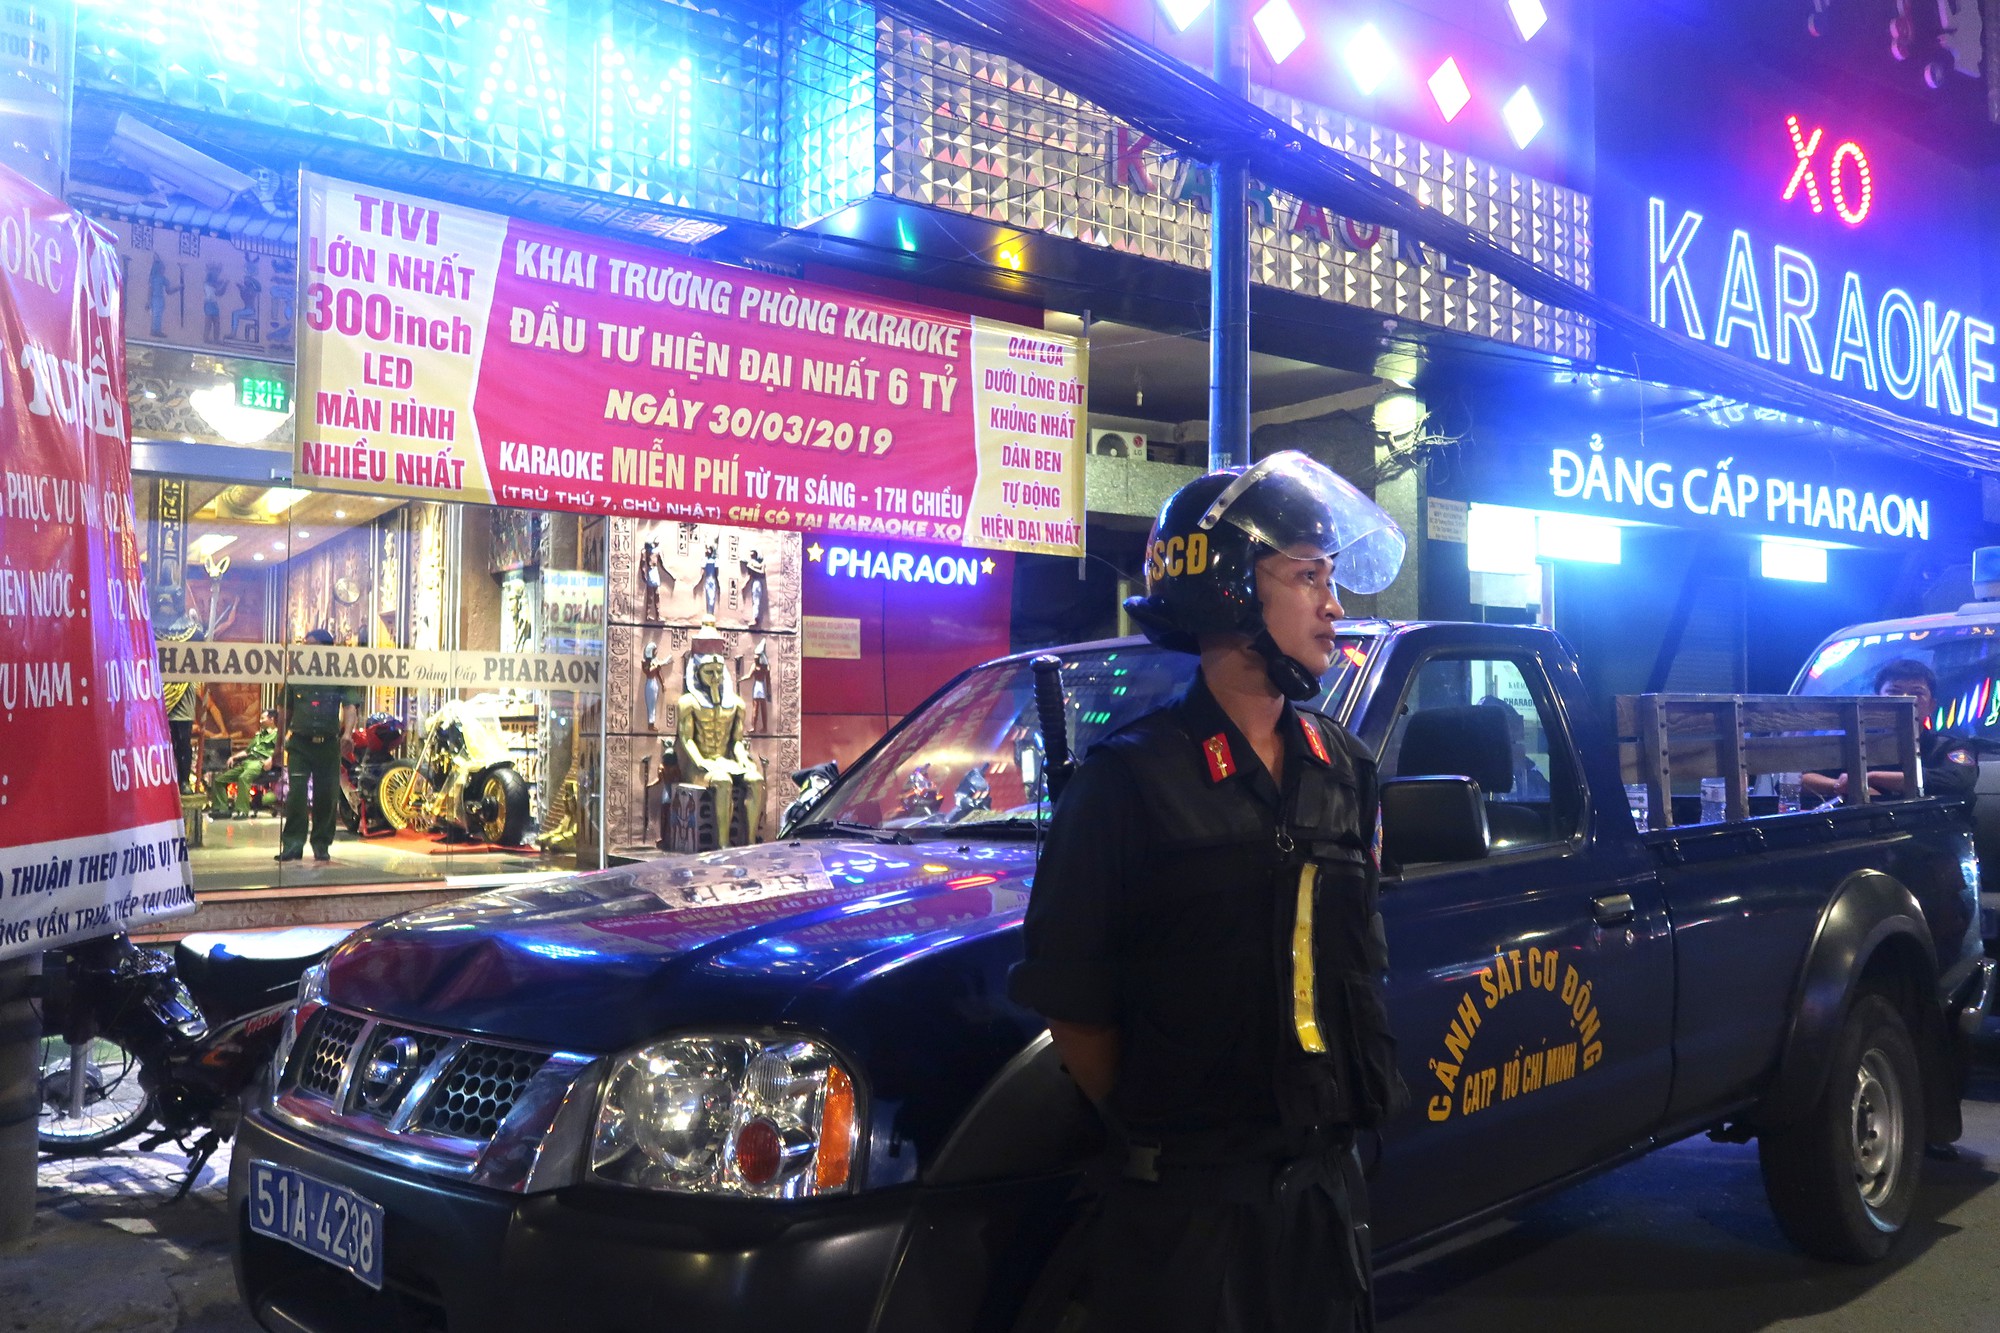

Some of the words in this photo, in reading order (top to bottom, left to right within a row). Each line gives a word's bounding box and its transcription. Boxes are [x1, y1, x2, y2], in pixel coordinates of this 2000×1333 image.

[1783, 115, 1873, 225] XO
[353, 193, 441, 246] TIVI
[308, 234, 377, 284] LỚN
[388, 253, 476, 301] NHẤT
[305, 282, 472, 355] 300inch
[515, 239, 596, 290] KHAI
[608, 258, 730, 316] TRƯƠNG
[739, 285, 836, 336] PHÒNG
[843, 305, 961, 358] KARAOKE
[1648, 196, 2000, 428] KARAOKE
[362, 352, 413, 390] LED
[509, 301, 586, 353] ĐẦU
[598, 321, 645, 362] TƯ
[651, 332, 729, 380] HIỆN
[739, 347, 792, 393] ĐẠI
[803, 356, 881, 402] NHẤT
[887, 367, 908, 406] 6
[920, 363, 958, 413] TỶ
[1039, 342, 1064, 367] LOA
[242, 390, 285, 410] EXIT
[984, 368, 1017, 395] DƯỚI
[1020, 371, 1055, 401] LÒNG
[1058, 376, 1085, 405] ĐẤT
[316, 389, 382, 433] MÀN
[390, 398, 455, 441] HÌNH
[603, 388, 704, 430] NGÀY
[708, 404, 894, 456] 30/03/2019
[990, 402, 1037, 434] KHỦNG
[1040, 411, 1076, 440] NHẤT
[302, 436, 387, 483] NHIỀU
[395, 447, 466, 491] NHẤT
[499, 441, 604, 482] KARAOKE
[611, 437, 686, 491] MIỄN
[694, 454, 740, 497] PHÍ
[744, 466, 772, 500] TỪ
[774, 474, 799, 503] 7H
[804, 473, 856, 509] SÁNG
[874, 486, 907, 514] 17H
[911, 485, 964, 520] CHIỀU
[1001, 442, 1031, 470] DÀN
[1034, 449, 1063, 473] BEN
[6, 471, 51, 534] PHỤC
[52, 477, 76, 537] VỤ
[1002, 481, 1020, 509] TỰ
[1022, 480, 1061, 511] ĐỘNG
[1549, 433, 1674, 509] ĐẲNG
[1682, 456, 1760, 518] CẤP
[1766, 478, 1930, 541] PHARAON
[555, 489, 595, 507] THỨ
[622, 496, 661, 513] CHỦ
[728, 503, 761, 522] CHỈ
[764, 506, 791, 525] CÓ
[795, 512, 823, 531] TẠI
[827, 512, 929, 538] KARAOKE
[931, 522, 963, 541] XO
[981, 513, 1014, 543] HIỆN
[1017, 519, 1042, 546] ĐẠI
[1045, 516, 1082, 546] NHẤT
[29, 560, 76, 619] NƯỚC
[827, 546, 979, 586] PHARAON
[24, 661, 74, 709] NAM
[157, 647, 284, 676] HARAON
[286, 650, 411, 680] KARAOKE
[483, 656, 601, 685] PHARAON
[111, 748, 130, 793] 05
[11, 855, 73, 898] THUẬN
[78, 850, 118, 885] THEO
[121, 842, 156, 876] TỪNG
[36, 906, 69, 939] VẤN
[142, 891, 161, 916] TẠI
[1427, 991, 1482, 1122] CẢNH
[1479, 944, 1523, 1009] SÁT
[1528, 947, 1559, 992] CƠ
[1560, 963, 1603, 1071] ĐỘNG
[1462, 1066, 1497, 1116] CATP
[1501, 1045, 1525, 1101] HỒ
[1522, 1037, 1547, 1094] CHÍ
[1544, 1041, 1578, 1087] MINH
